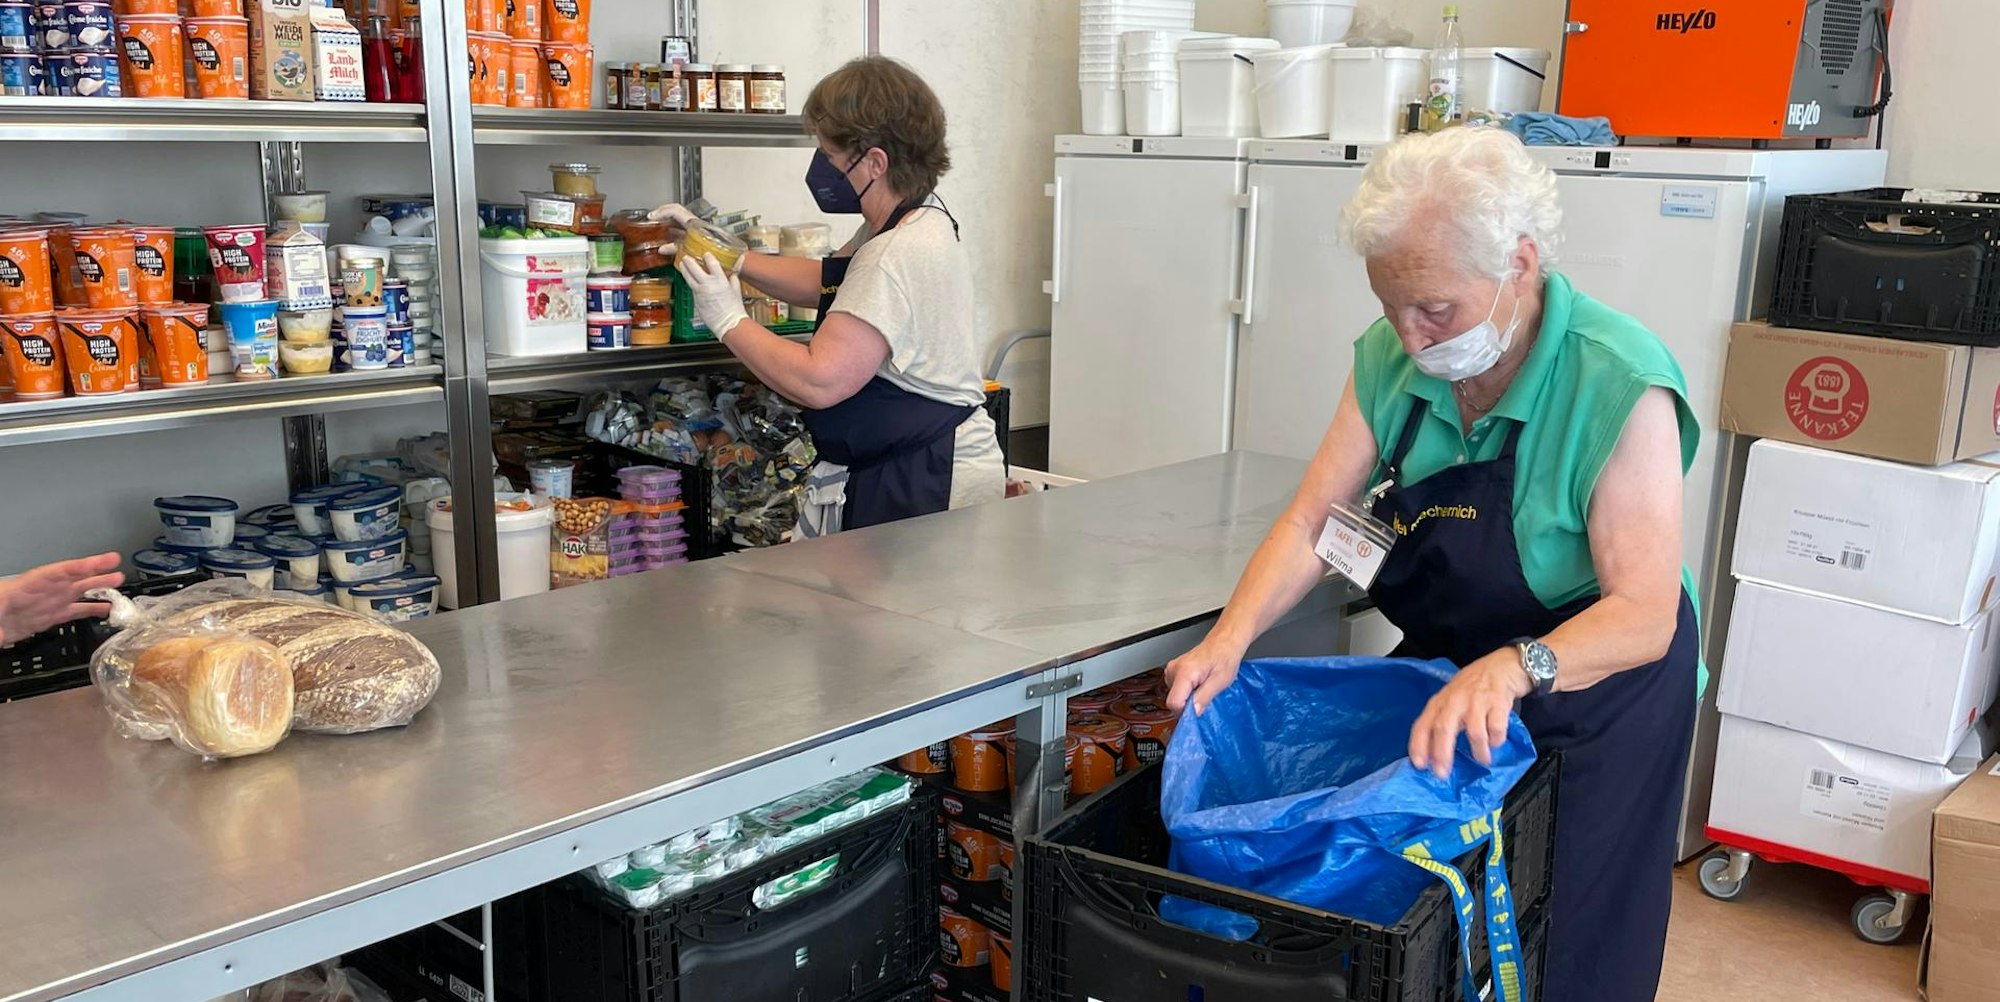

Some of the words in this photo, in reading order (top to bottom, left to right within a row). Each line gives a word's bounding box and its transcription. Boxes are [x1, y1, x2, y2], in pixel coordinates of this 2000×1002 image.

[1656, 9, 1716, 34] HEYLO
[273, 25, 303, 34] WEIDE
[275, 32, 304, 41] MILCH
[329, 66, 359, 79] Milch
[1787, 100, 1821, 131] HEYLO
[223, 248, 242, 257] HIGH
[22, 340, 43, 348] HIGH
[90, 340, 111, 348] HIGH
[23, 347, 51, 355] PROTEIN
[91, 347, 117, 355] PROTEIN
[1788, 391, 1865, 436] TEEKANNE
[1335, 528, 1353, 546] TAFEL
[562, 542, 586, 554] HAK
[1326, 549, 1353, 575] Wilma
[1137, 743, 1158, 752] HIGH
